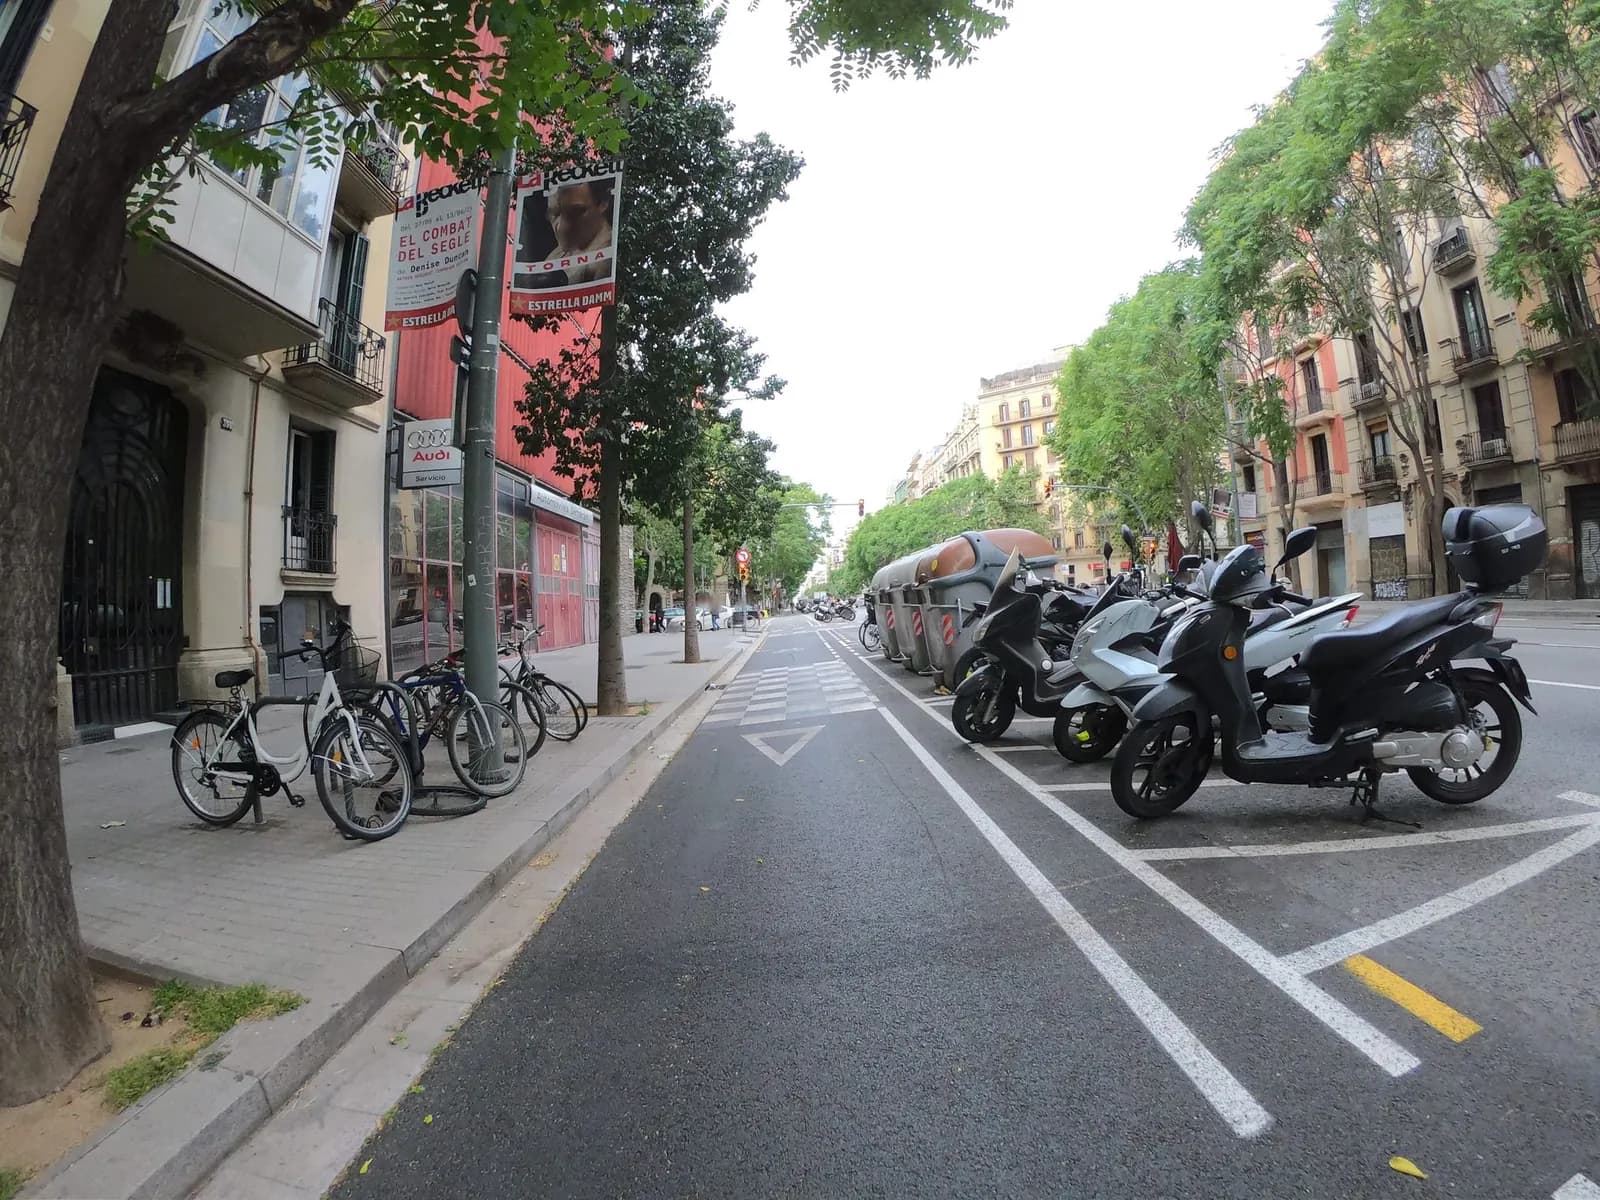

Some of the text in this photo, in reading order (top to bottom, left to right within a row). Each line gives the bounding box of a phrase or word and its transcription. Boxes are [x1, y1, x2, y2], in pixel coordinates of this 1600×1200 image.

[515, 169, 541, 188] La
[400, 216, 472, 248] EL COMBAT
[398, 232, 471, 263] DEL SEGLE
[411, 261, 440, 273] Denise
[527, 251, 605, 271] TORNA
[528, 291, 612, 311] ESTRELLA DAMM
[402, 311, 446, 327] ESTRELLA
[412, 450, 450, 462] Audi
